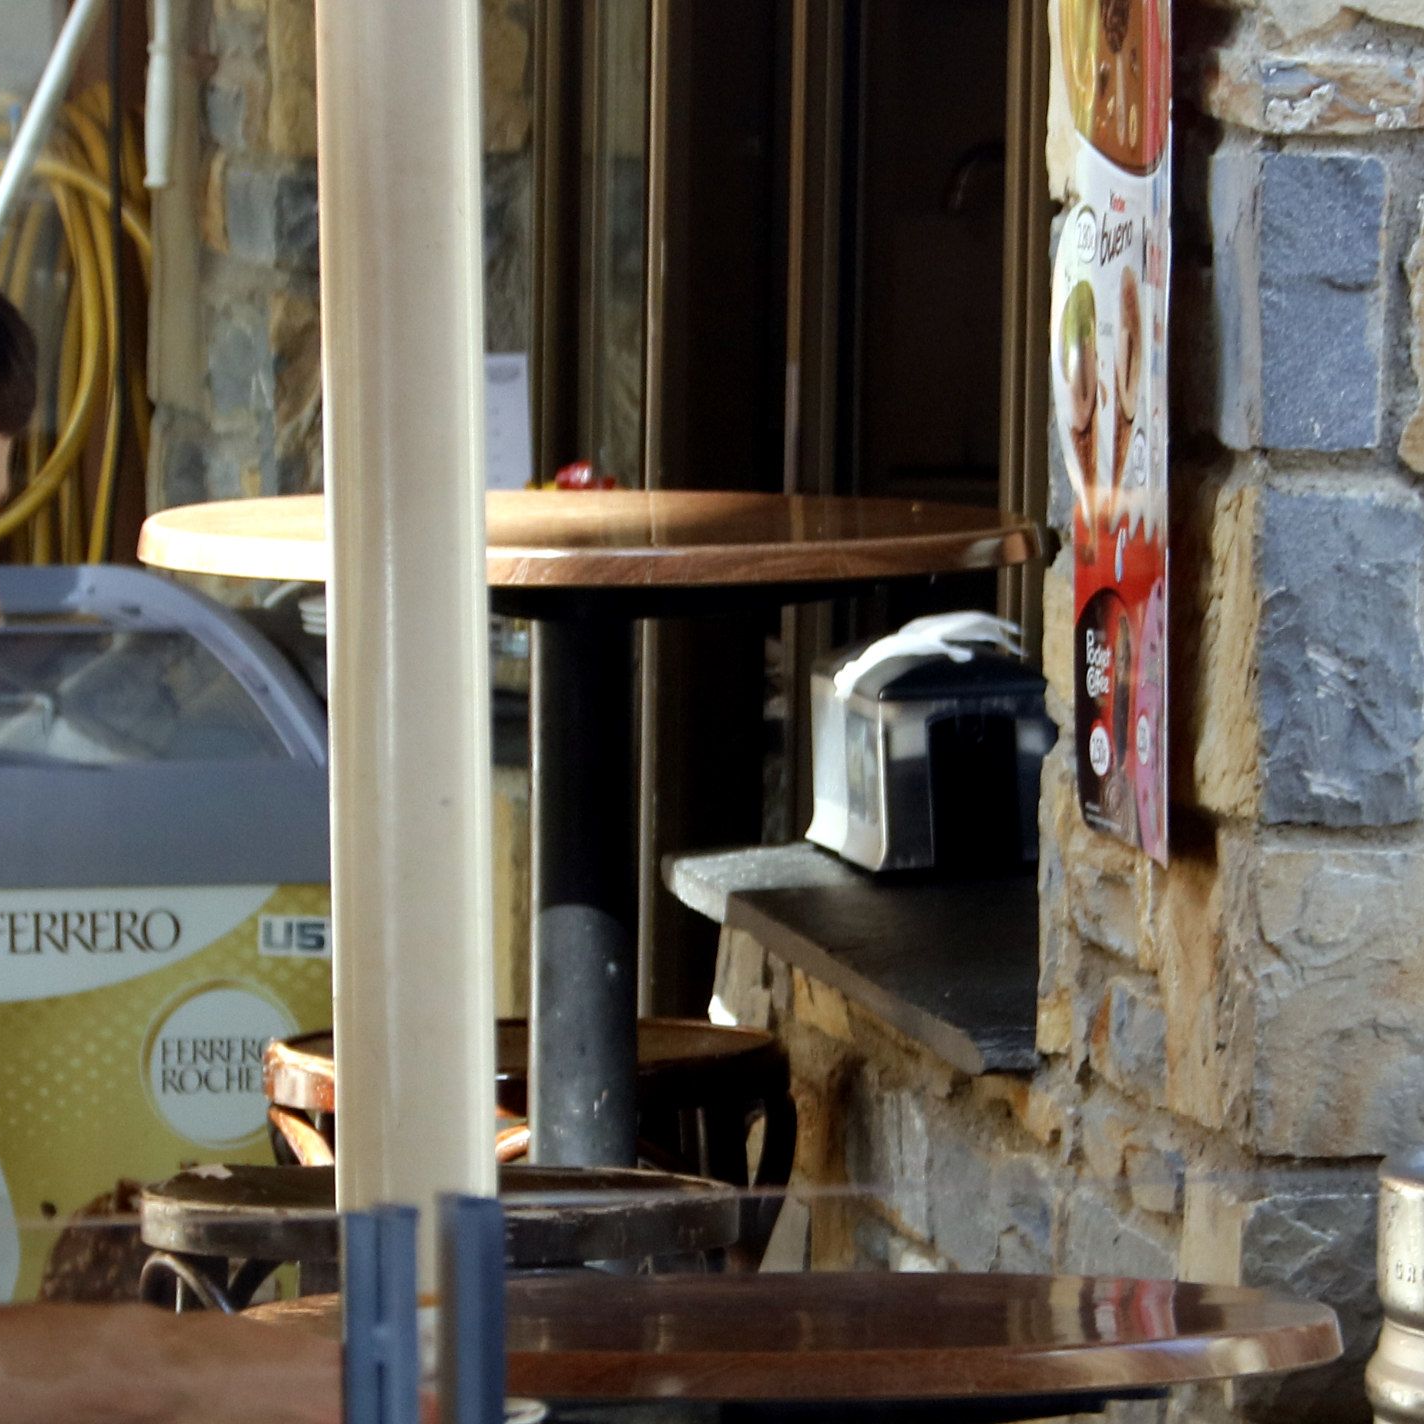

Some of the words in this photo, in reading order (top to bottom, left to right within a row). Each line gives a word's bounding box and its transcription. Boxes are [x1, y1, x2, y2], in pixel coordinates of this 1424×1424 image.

[1099, 211, 1133, 267] bueno
[160, 1037, 265, 1065] FERRER
[160, 1066, 265, 1095] ROCHE
